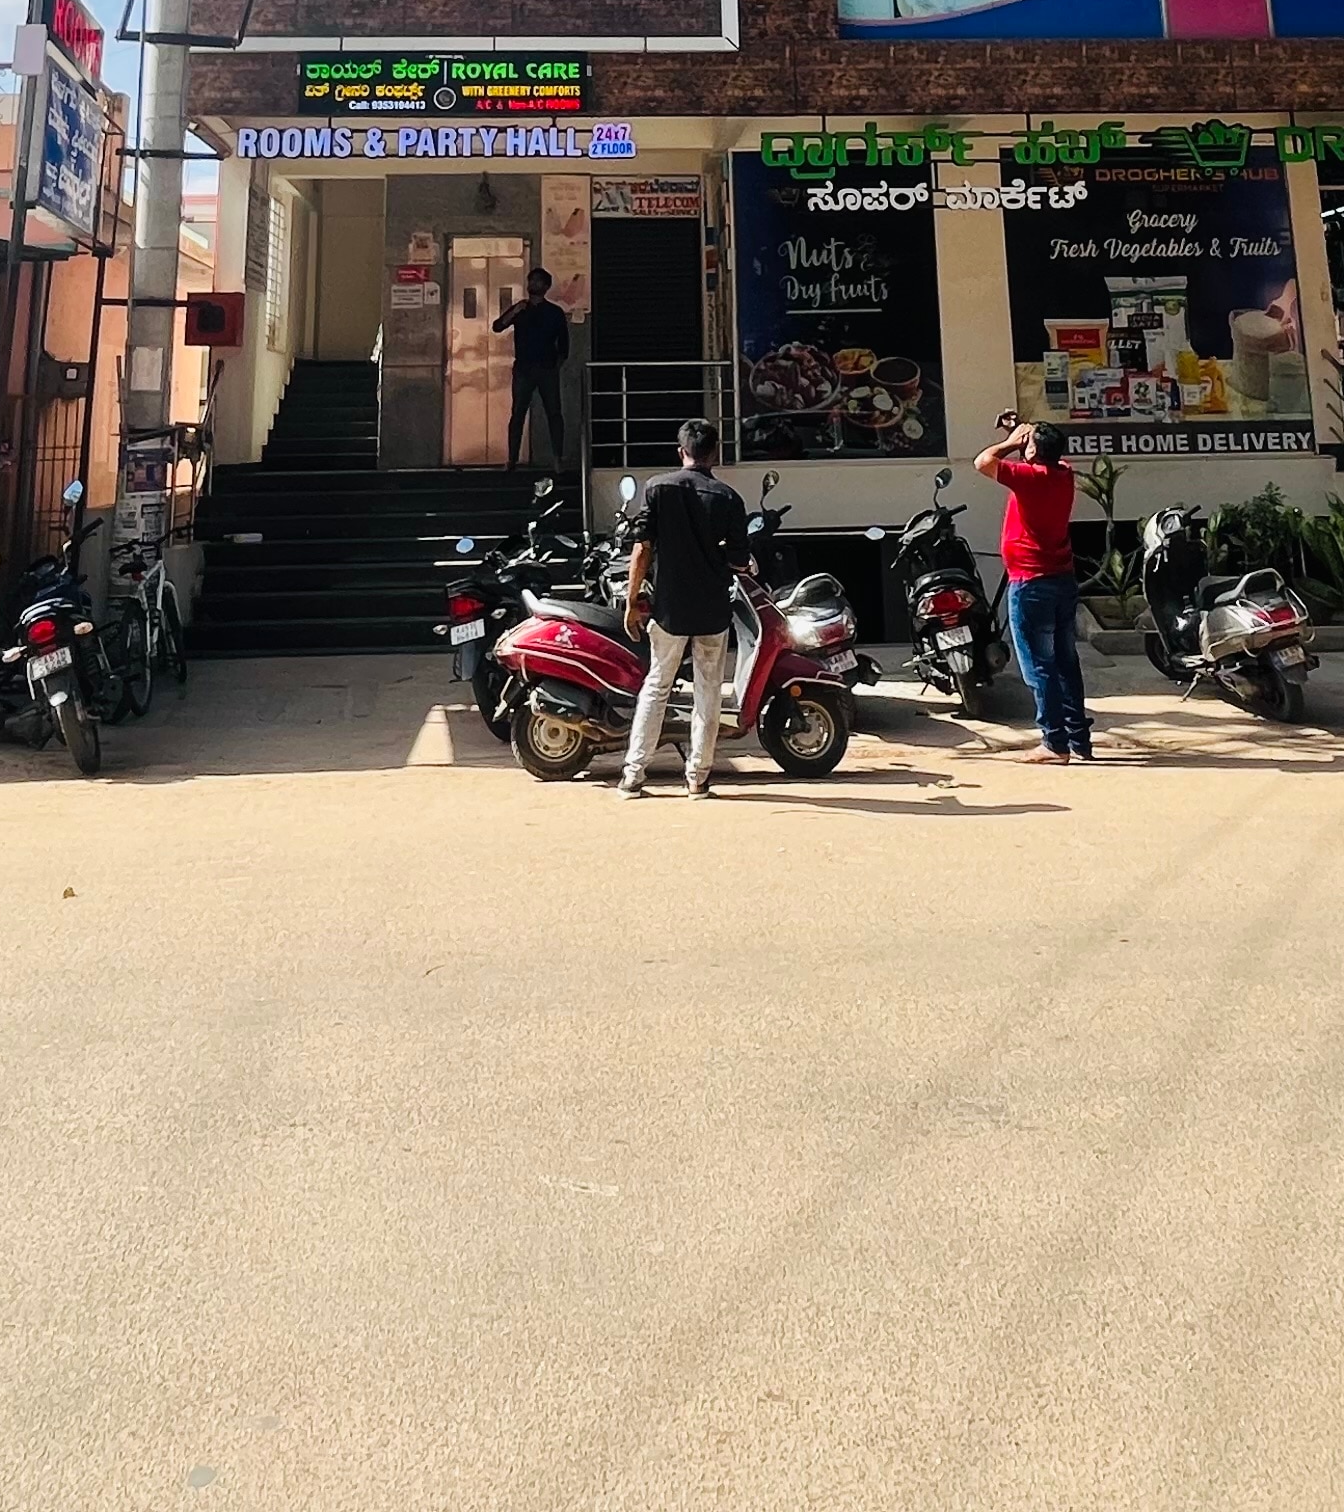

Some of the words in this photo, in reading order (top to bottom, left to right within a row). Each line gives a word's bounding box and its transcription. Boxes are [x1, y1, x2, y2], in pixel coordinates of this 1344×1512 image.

[452, 63, 519, 79] ROYAL
[525, 63, 580, 80] CARE
[462, 86, 484, 96] WITH
[487, 86, 531, 96] GREENERY
[533, 86, 580, 97] COMFORTS
[238, 128, 353, 158] ROOMS
[363, 129, 387, 158] &
[398, 128, 497, 157] PARTY
[506, 128, 583, 157] HALL
[602, 143, 632, 154] FLOOR
[635, 197, 700, 208] TELECOM
[778, 236, 855, 271] Nuts
[1104, 238, 1204, 263] Vegetables
[1209, 238, 1223, 258] &
[1229, 237, 1282, 257] Fruits
[779, 275, 821, 308] Dry
[1068, 435, 1113, 453] REE
[1122, 434, 1189, 452] HOME
[1198, 432, 1311, 451] DELIVERY
